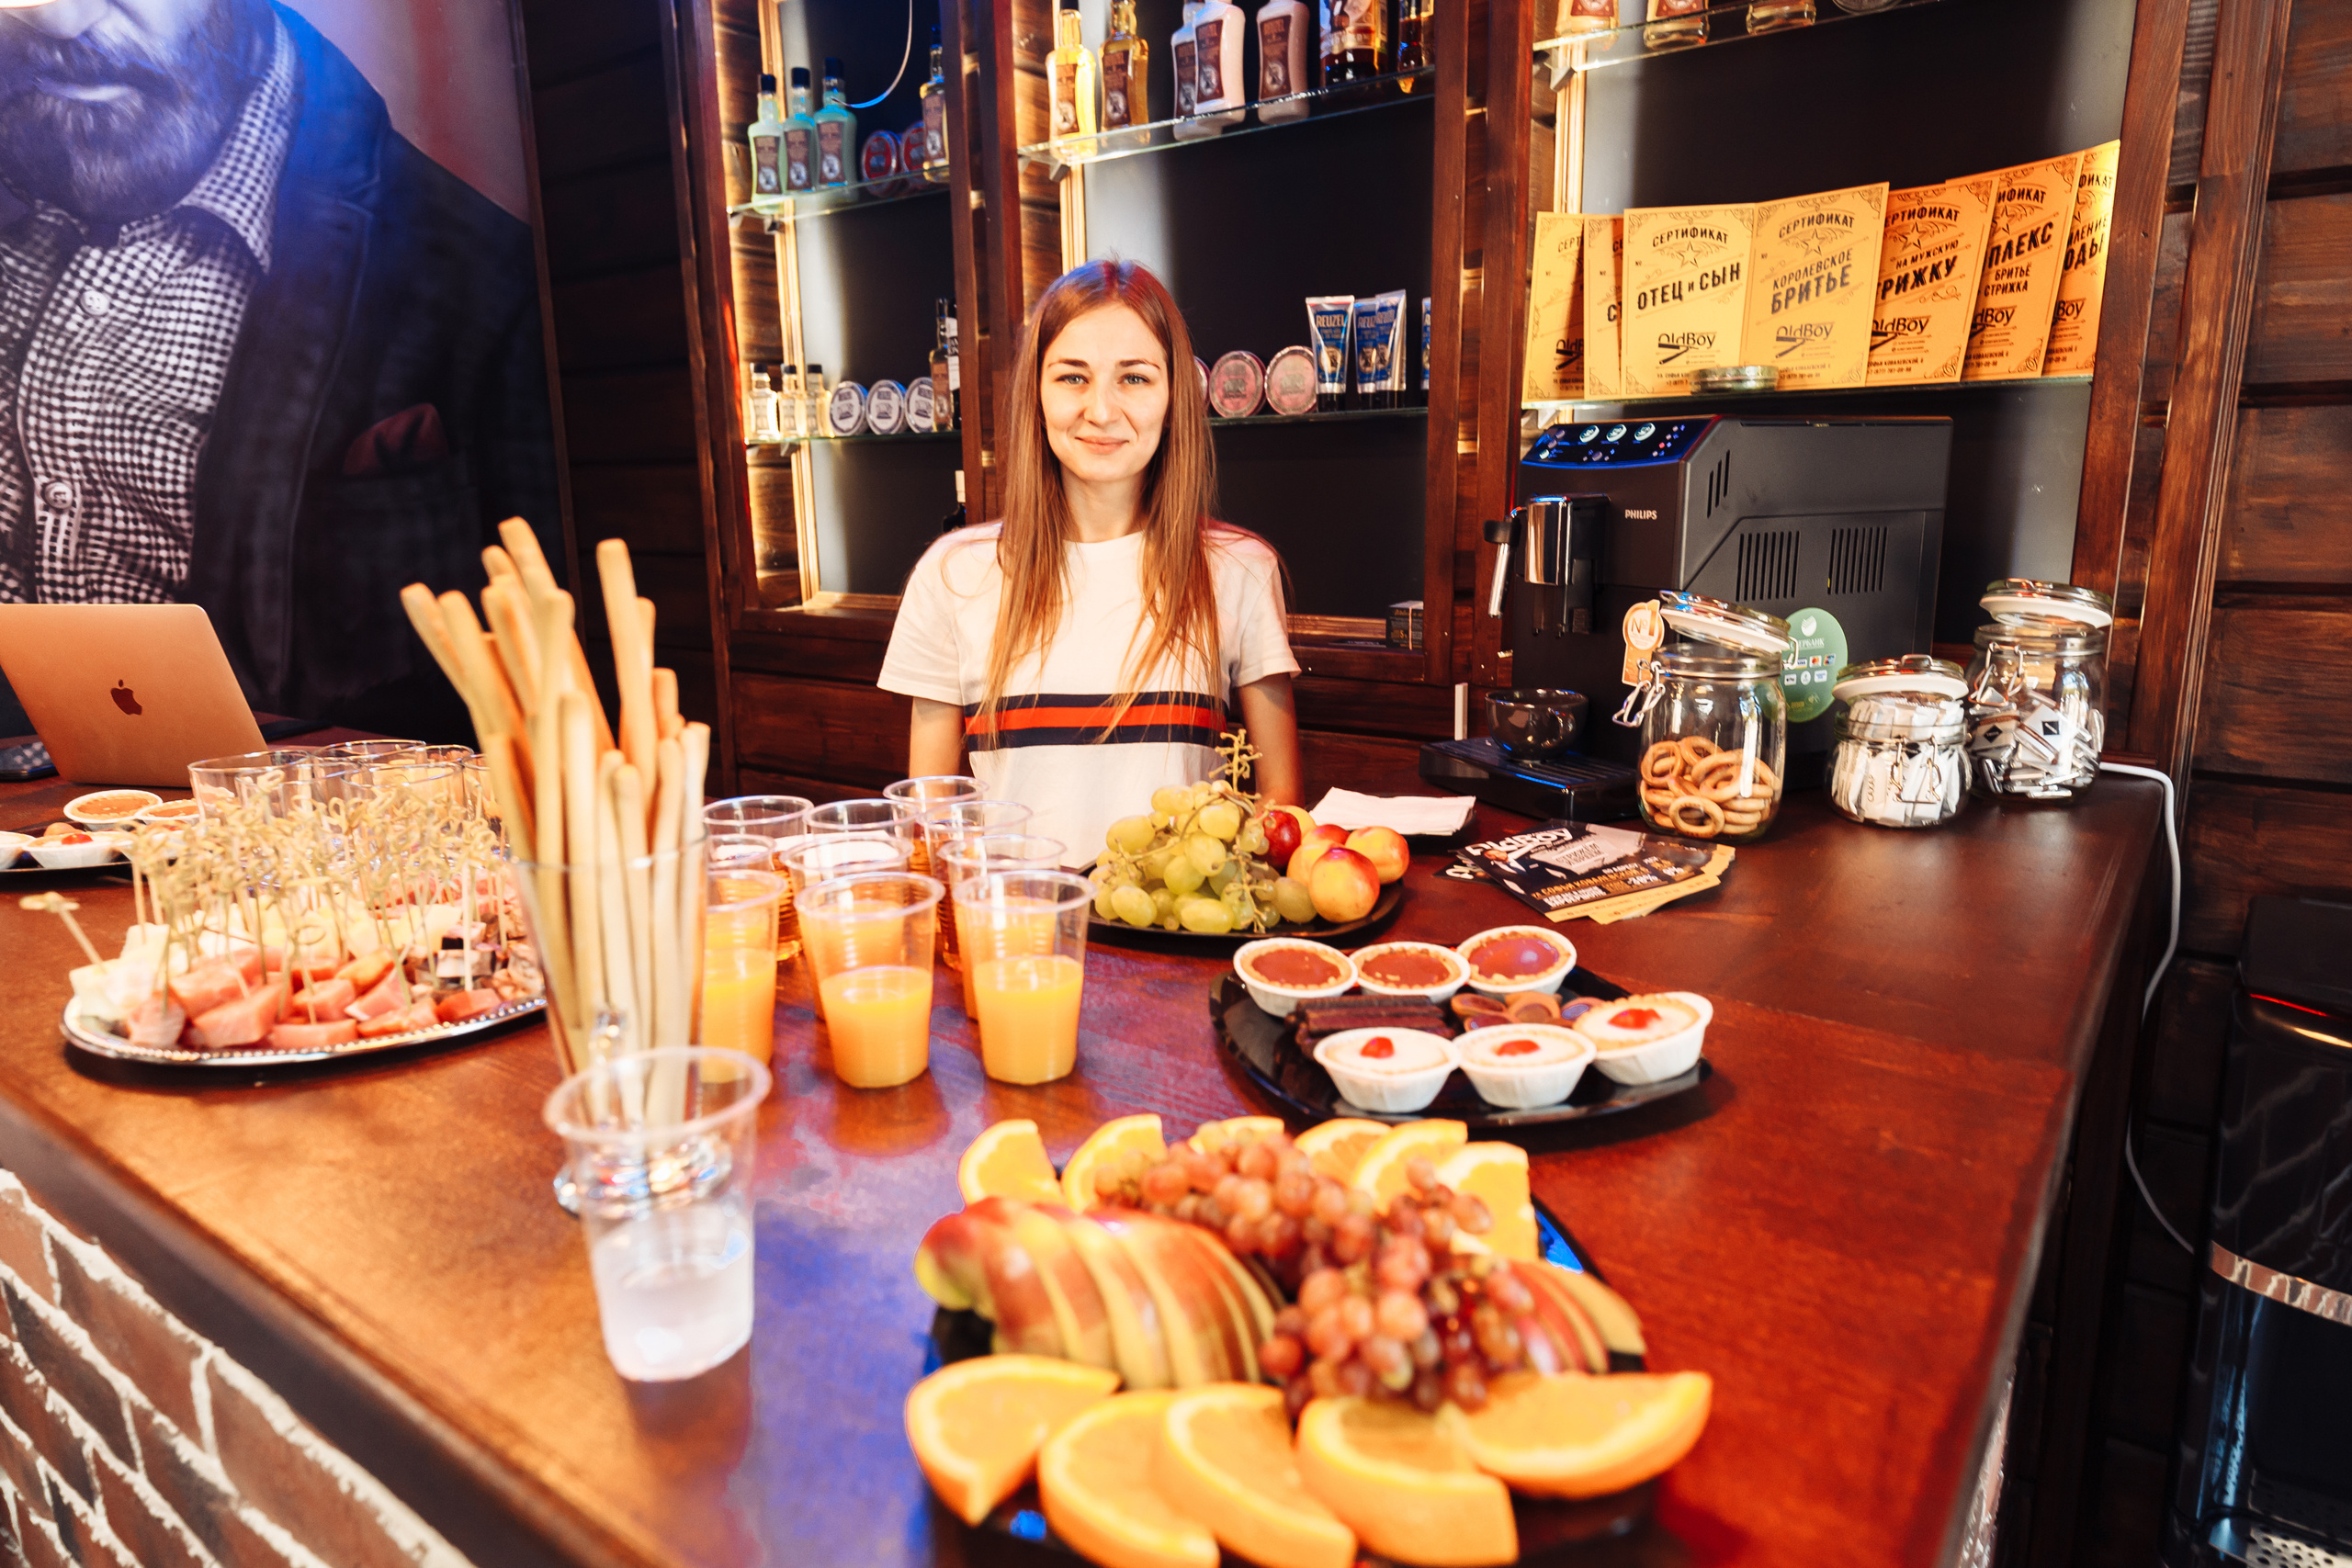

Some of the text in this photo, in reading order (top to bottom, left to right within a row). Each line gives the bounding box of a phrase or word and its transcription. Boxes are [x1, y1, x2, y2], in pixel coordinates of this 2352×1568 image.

[2078, 173, 2112, 189] ФИКАТ
[1997, 187, 2047, 204] ИФИКАТ
[1779, 212, 1855, 239] СЕРТИФИКАТ
[1884, 207, 1960, 228] ЕРТИФИКАТ
[1652, 226, 1729, 248] СЕРТИФИКАТ
[1987, 221, 2053, 269] ПЛЕКС
[1895, 239, 1959, 270] НА МУЖСКУЮ
[2064, 232, 2104, 271] ОДЫ
[1773, 247, 1854, 291] КОРОЛЕВСКОЕ
[1878, 255, 1958, 300] РИЖКУ
[1637, 280, 1683, 310] ОТЕЦ
[1699, 262, 1740, 291] СЫН
[1770, 264, 1852, 314] БРИТЬЕ
[1984, 279, 2029, 297] СТРИЖКА
[1973, 308, 2016, 327] dBoy
[2056, 299, 2085, 320] Boy
[1316, 313, 1345, 328] REUZEL
[1358, 315, 1376, 329] REUZ
[1657, 332, 1716, 349] OldBoy
[1775, 322, 1835, 342] OldBoy
[1624, 509, 1657, 520] PHILIPS
[1790, 637, 1825, 649] СЕРБАНК
[1464, 827, 1573, 856] OldBoy
